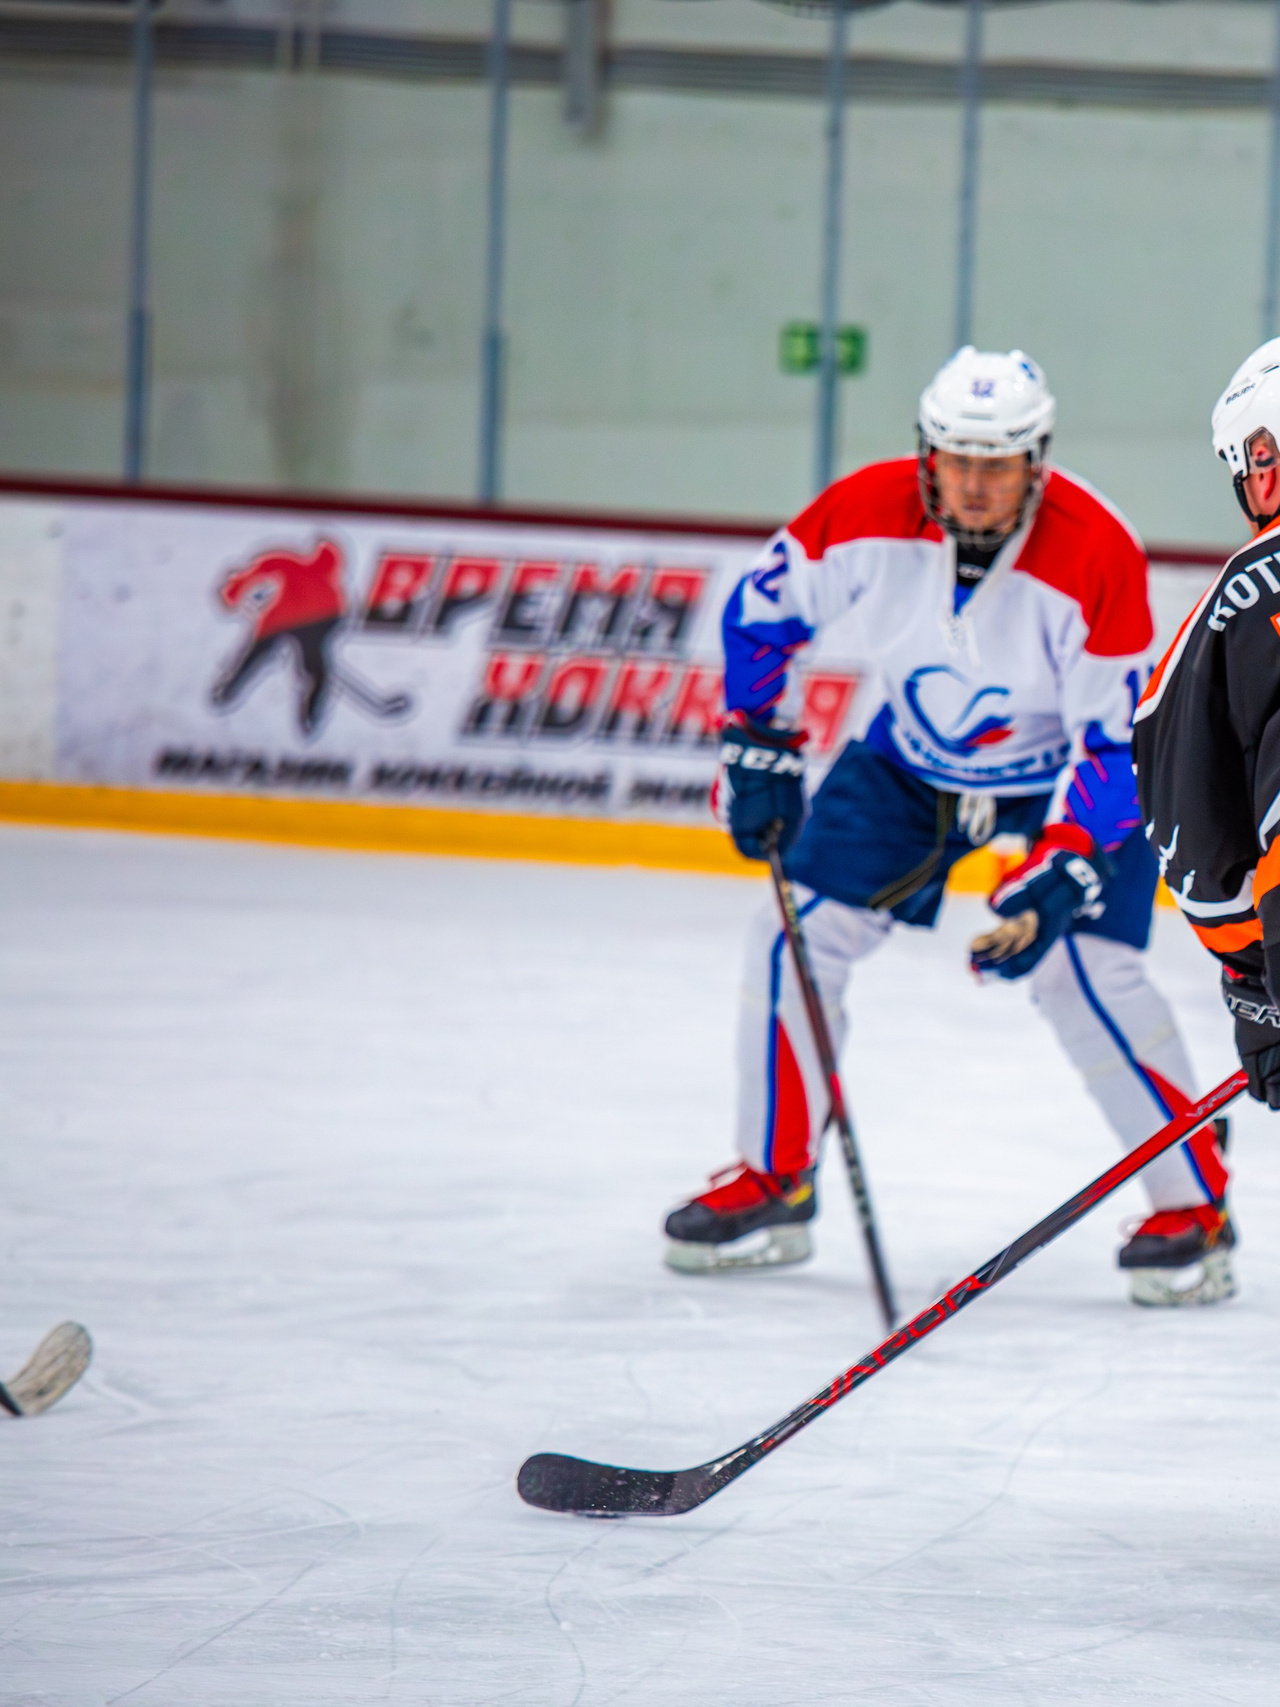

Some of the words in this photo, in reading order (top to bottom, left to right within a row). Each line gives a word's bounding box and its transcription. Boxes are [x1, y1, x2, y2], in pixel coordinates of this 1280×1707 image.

[364, 550, 708, 645] ВРЕМЯ
[751, 541, 789, 604] 2
[463, 652, 860, 754] ХОККЯ
[808, 1274, 992, 1407] VAPOR
